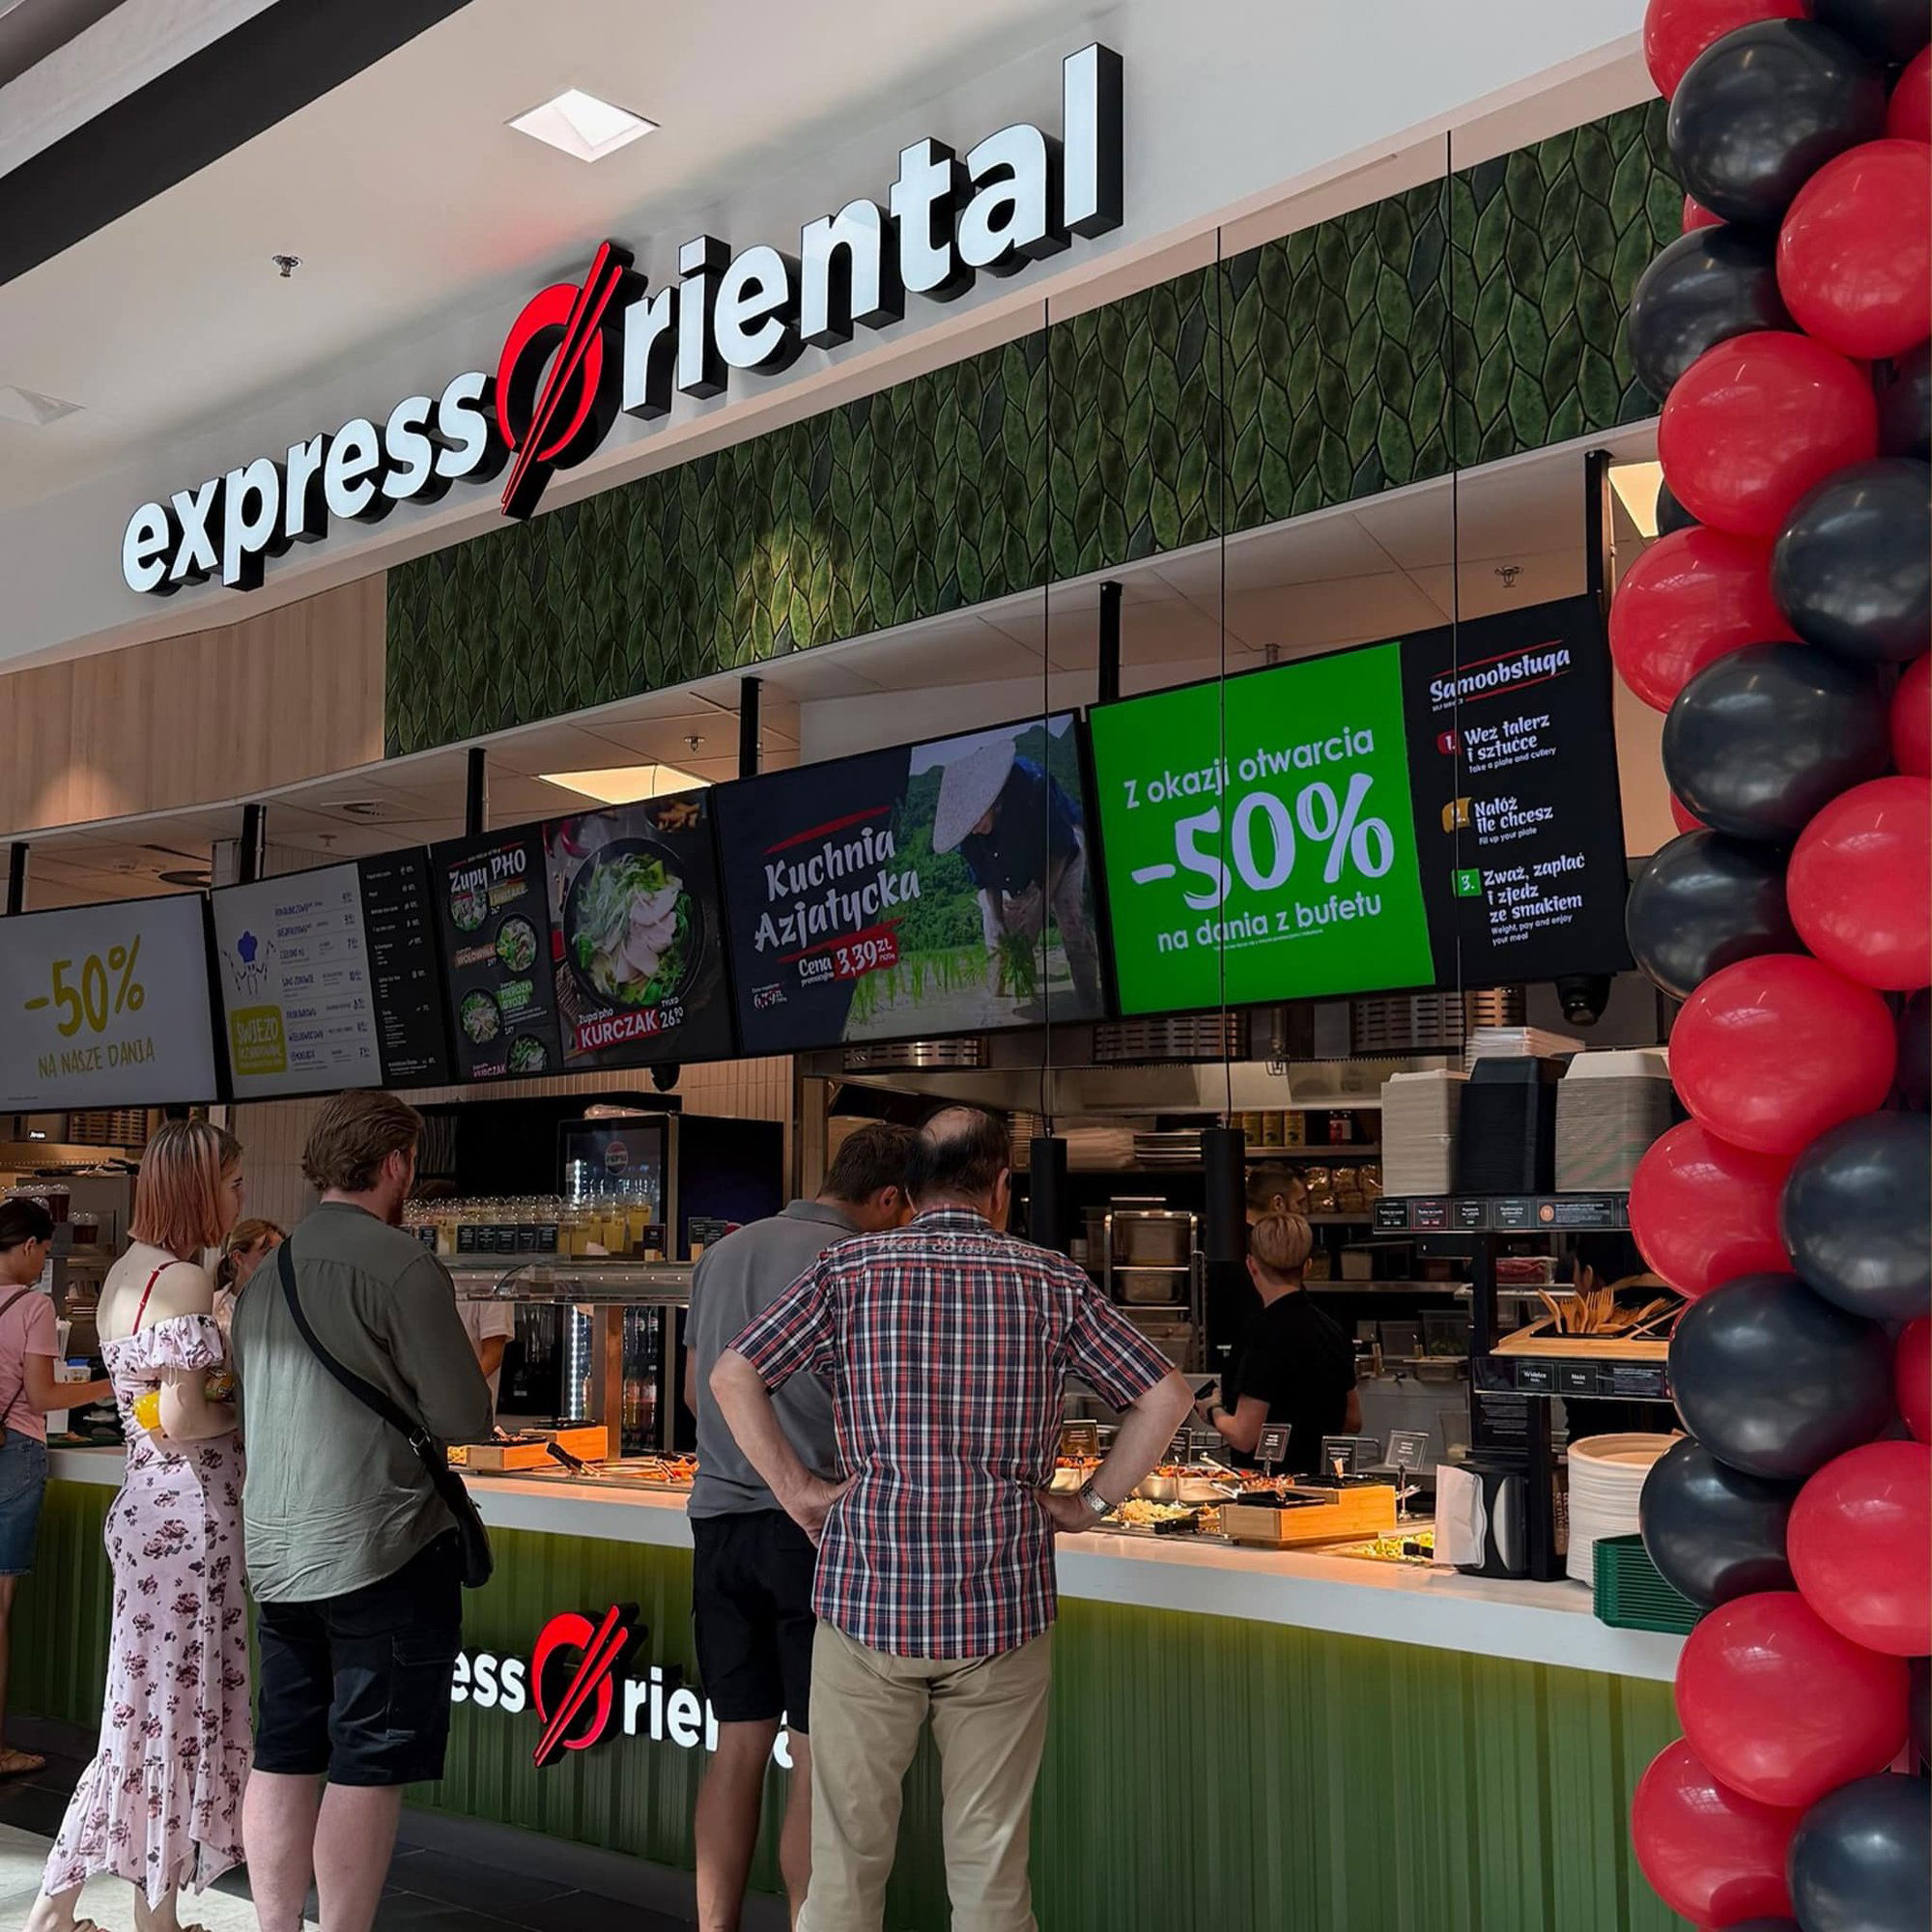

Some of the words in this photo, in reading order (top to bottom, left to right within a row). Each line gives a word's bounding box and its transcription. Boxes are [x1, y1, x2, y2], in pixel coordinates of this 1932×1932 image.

[1430, 648, 1571, 703] Samoobsługa
[1502, 714, 1550, 737] talerz
[1147, 756, 1230, 803] okazji
[1238, 726, 1375, 781] otwarcia
[1466, 747, 1474, 762] i
[1477, 734, 1538, 760] sztućce
[1468, 764, 1487, 774] Take
[1494, 757, 1513, 770] plate
[1514, 753, 1529, 763] and
[1489, 835, 1499, 845] up
[1500, 831, 1517, 842] your
[1518, 827, 1538, 838] plate
[1499, 807, 1553, 829] chcesz
[1130, 773, 1395, 911] -50%
[449, 867, 489, 893] Zupy
[490, 848, 526, 880] PHO
[764, 827, 895, 901] Kuchnia
[1461, 874, 1474, 891] 3.
[1483, 867, 1529, 887] Zważ,
[1533, 853, 1585, 877] zapłać
[754, 869, 921, 952] Azjatycka
[1487, 890, 1493, 905] i
[1498, 882, 1539, 906] zjedz
[1490, 909, 1507, 923] ze
[1511, 895, 1582, 920] smakiem
[1157, 928, 1188, 953] na
[1196, 912, 1268, 945] dania
[1275, 912, 1290, 931] z
[1295, 891, 1382, 927] bufetu
[1492, 938, 1509, 947] your
[1510, 931, 1528, 943] meal
[1520, 921, 1534, 933] pay
[1535, 918, 1550, 927] and
[1551, 914, 1573, 924] enjoy
[798, 955, 833, 978] Cena
[836, 939, 877, 977] 3,39
[24, 934, 145, 1037] -50%
[581, 1009, 658, 1048] KURCZAK
[38, 1053, 57, 1079] NA
[61, 1047, 103, 1074] NASZE
[107, 1037, 156, 1066] DANIA
